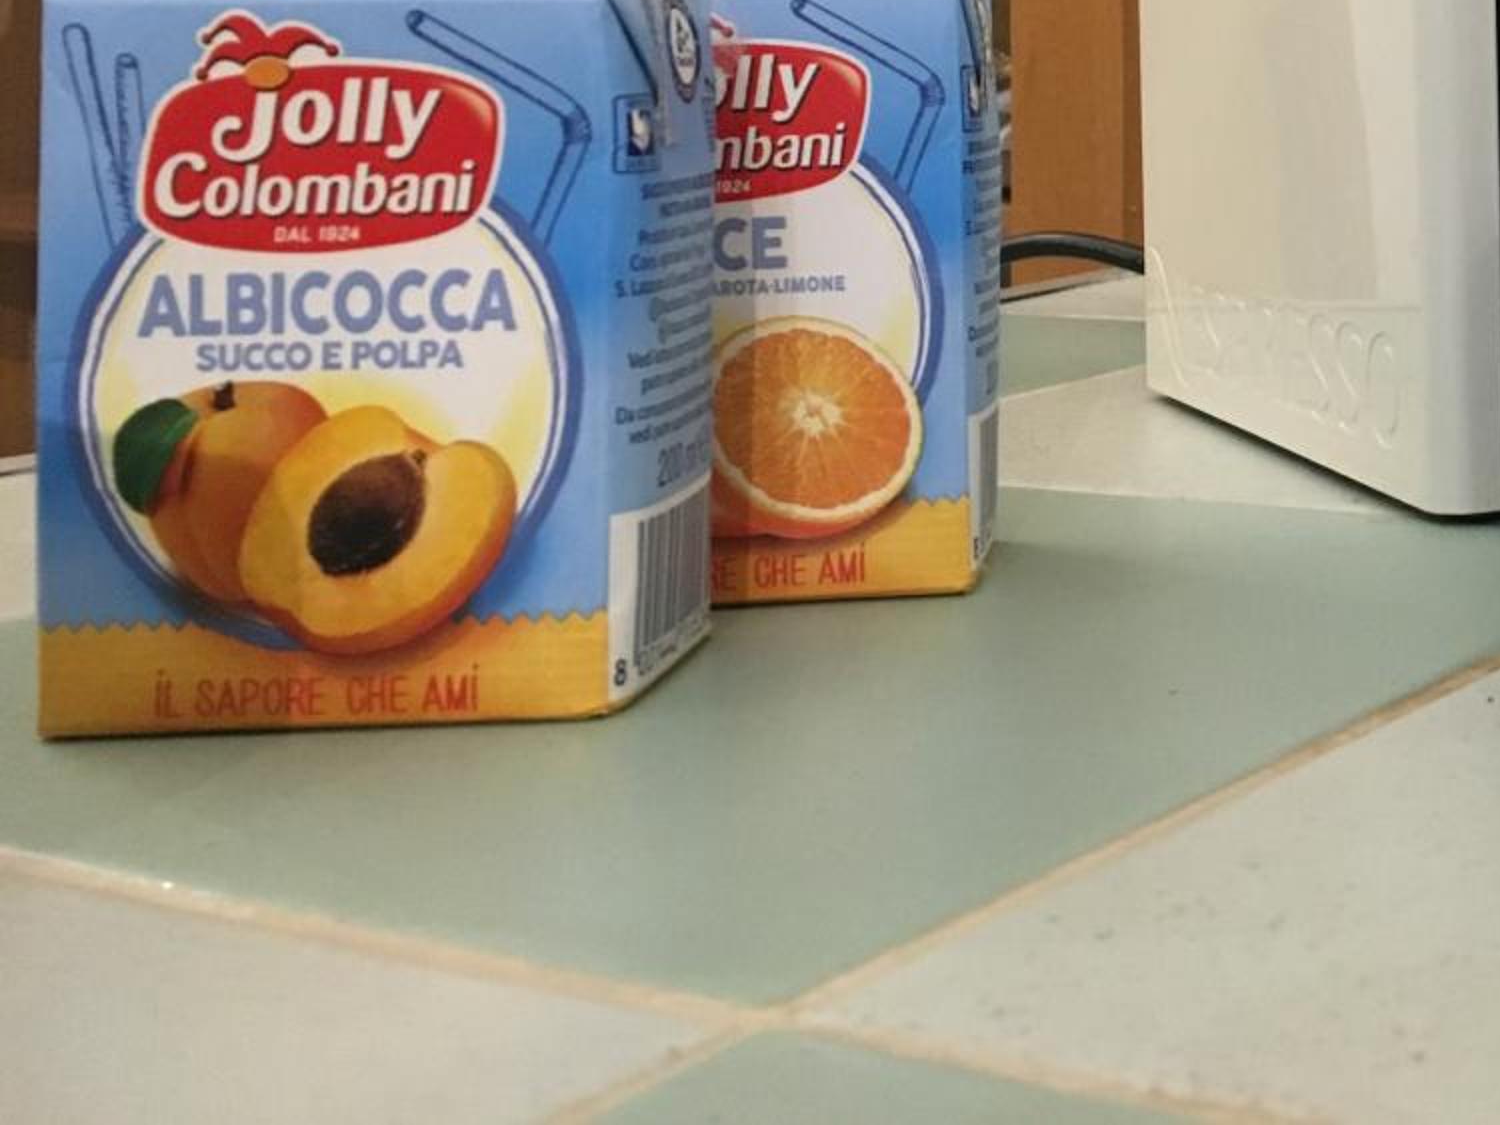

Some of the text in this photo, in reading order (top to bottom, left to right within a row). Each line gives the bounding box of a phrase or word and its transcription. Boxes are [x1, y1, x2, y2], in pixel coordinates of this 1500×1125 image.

[154, 152, 476, 218] Colombani
[274, 225, 360, 243] DAL 1924
[713, 216, 788, 271] CE
[138, 269, 517, 337] ALBICOCCA
[197, 340, 463, 371] SUCCO E POLPA
[196, 676, 325, 718] SAPORE
